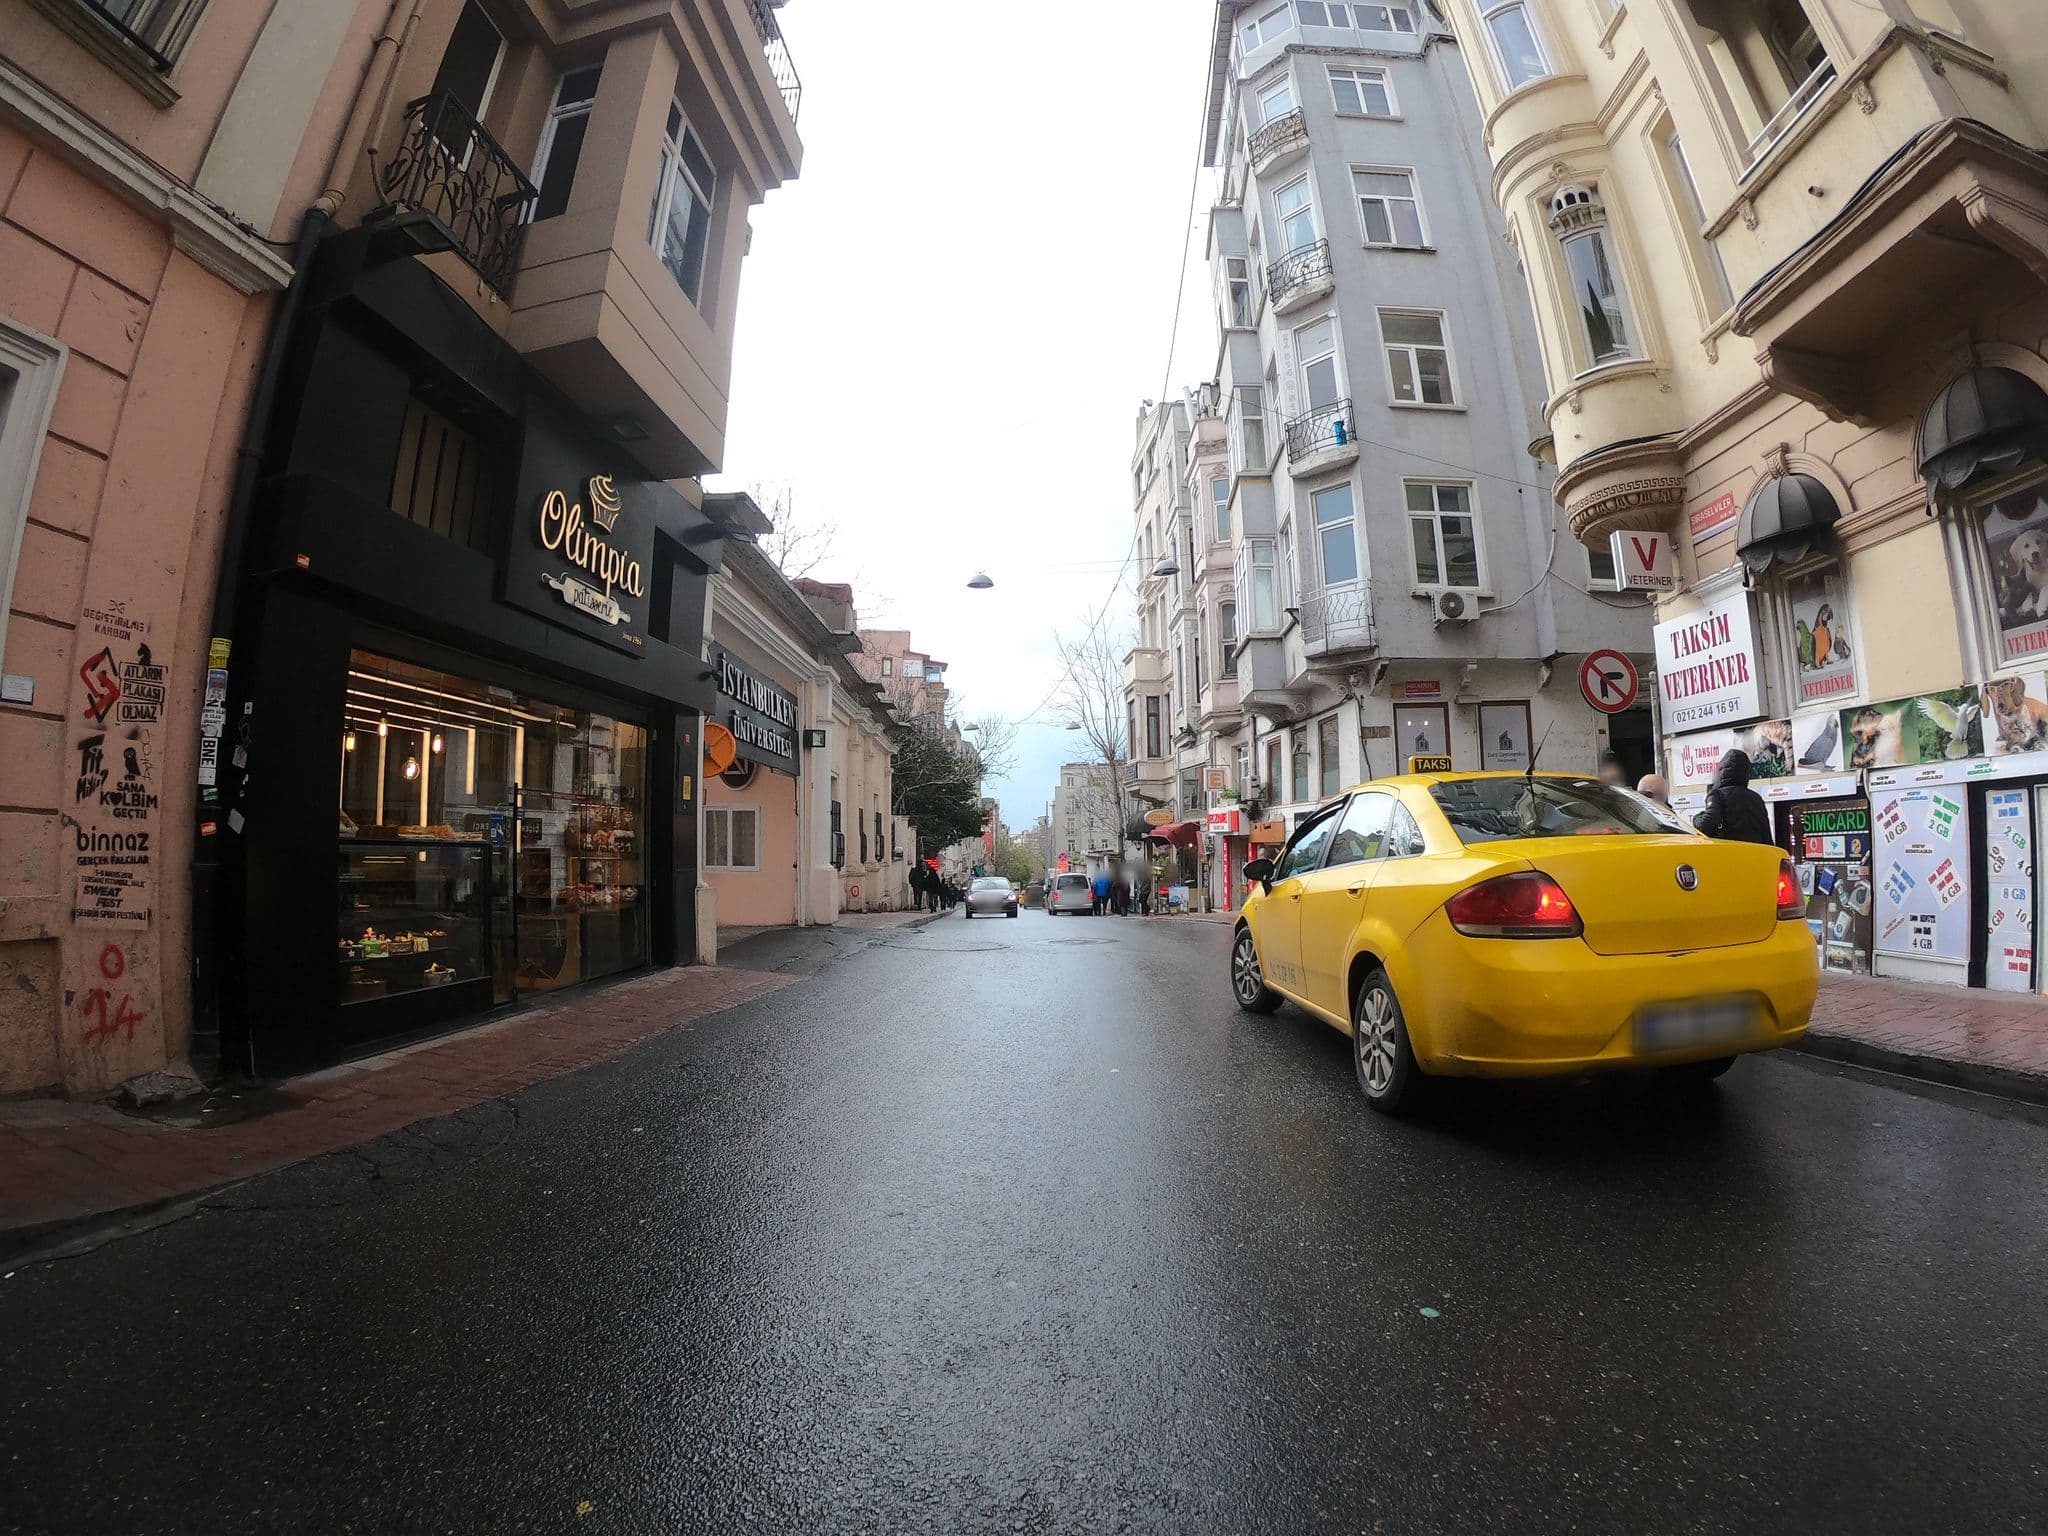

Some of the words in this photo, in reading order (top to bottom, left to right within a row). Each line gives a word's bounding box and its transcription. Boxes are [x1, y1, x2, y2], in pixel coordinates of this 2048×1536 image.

[541, 490, 644, 598] Olimpia
[1631, 537, 1658, 571] V
[1627, 574, 1673, 586] VETERİNER
[1670, 611, 1731, 660] TAKSİM
[124, 665, 163, 680] ATLARIN
[1664, 653, 1750, 702] VETERİNER
[123, 683, 161, 701] PLAKASI
[1803, 674, 1854, 697] VETERİNER
[122, 705, 157, 719] OLMAZ
[1677, 709, 1696, 723] 0212
[1698, 705, 1713, 719] 244
[1716, 702, 1727, 715] 16
[1729, 699, 1740, 713] 91
[202, 739, 216, 767] BNE
[1416, 759, 1450, 771] TAKSİ
[117, 782, 145, 792] SANA
[1804, 811, 1866, 832] SIMCARD
[1928, 819, 1935, 830] 2
[1936, 824, 1950, 838] GB
[77, 826, 149, 851] binnaz
[1885, 831, 1895, 843] 10
[1895, 821, 1908, 836] GB
[2004, 826, 2011, 836] 2
[2012, 833, 2026, 850] GB
[1993, 856, 2006, 874] GB
[2017, 860, 2024, 869] 4
[83, 885, 122, 897] SWEAT
[1883, 881, 1891, 891] 8
[1889, 888, 1902, 904] GB
[1941, 893, 1948, 904] 6
[1947, 882, 1961, 898] GB
[2003, 888, 2008, 899] 8
[2011, 888, 2026, 900] GB
[96, 897, 123, 908] FEST
[1992, 909, 2005, 926] GB
[2015, 908, 2027, 923] 10
[1912, 938, 1917, 948] 4
[1920, 939, 1932, 949] GB
